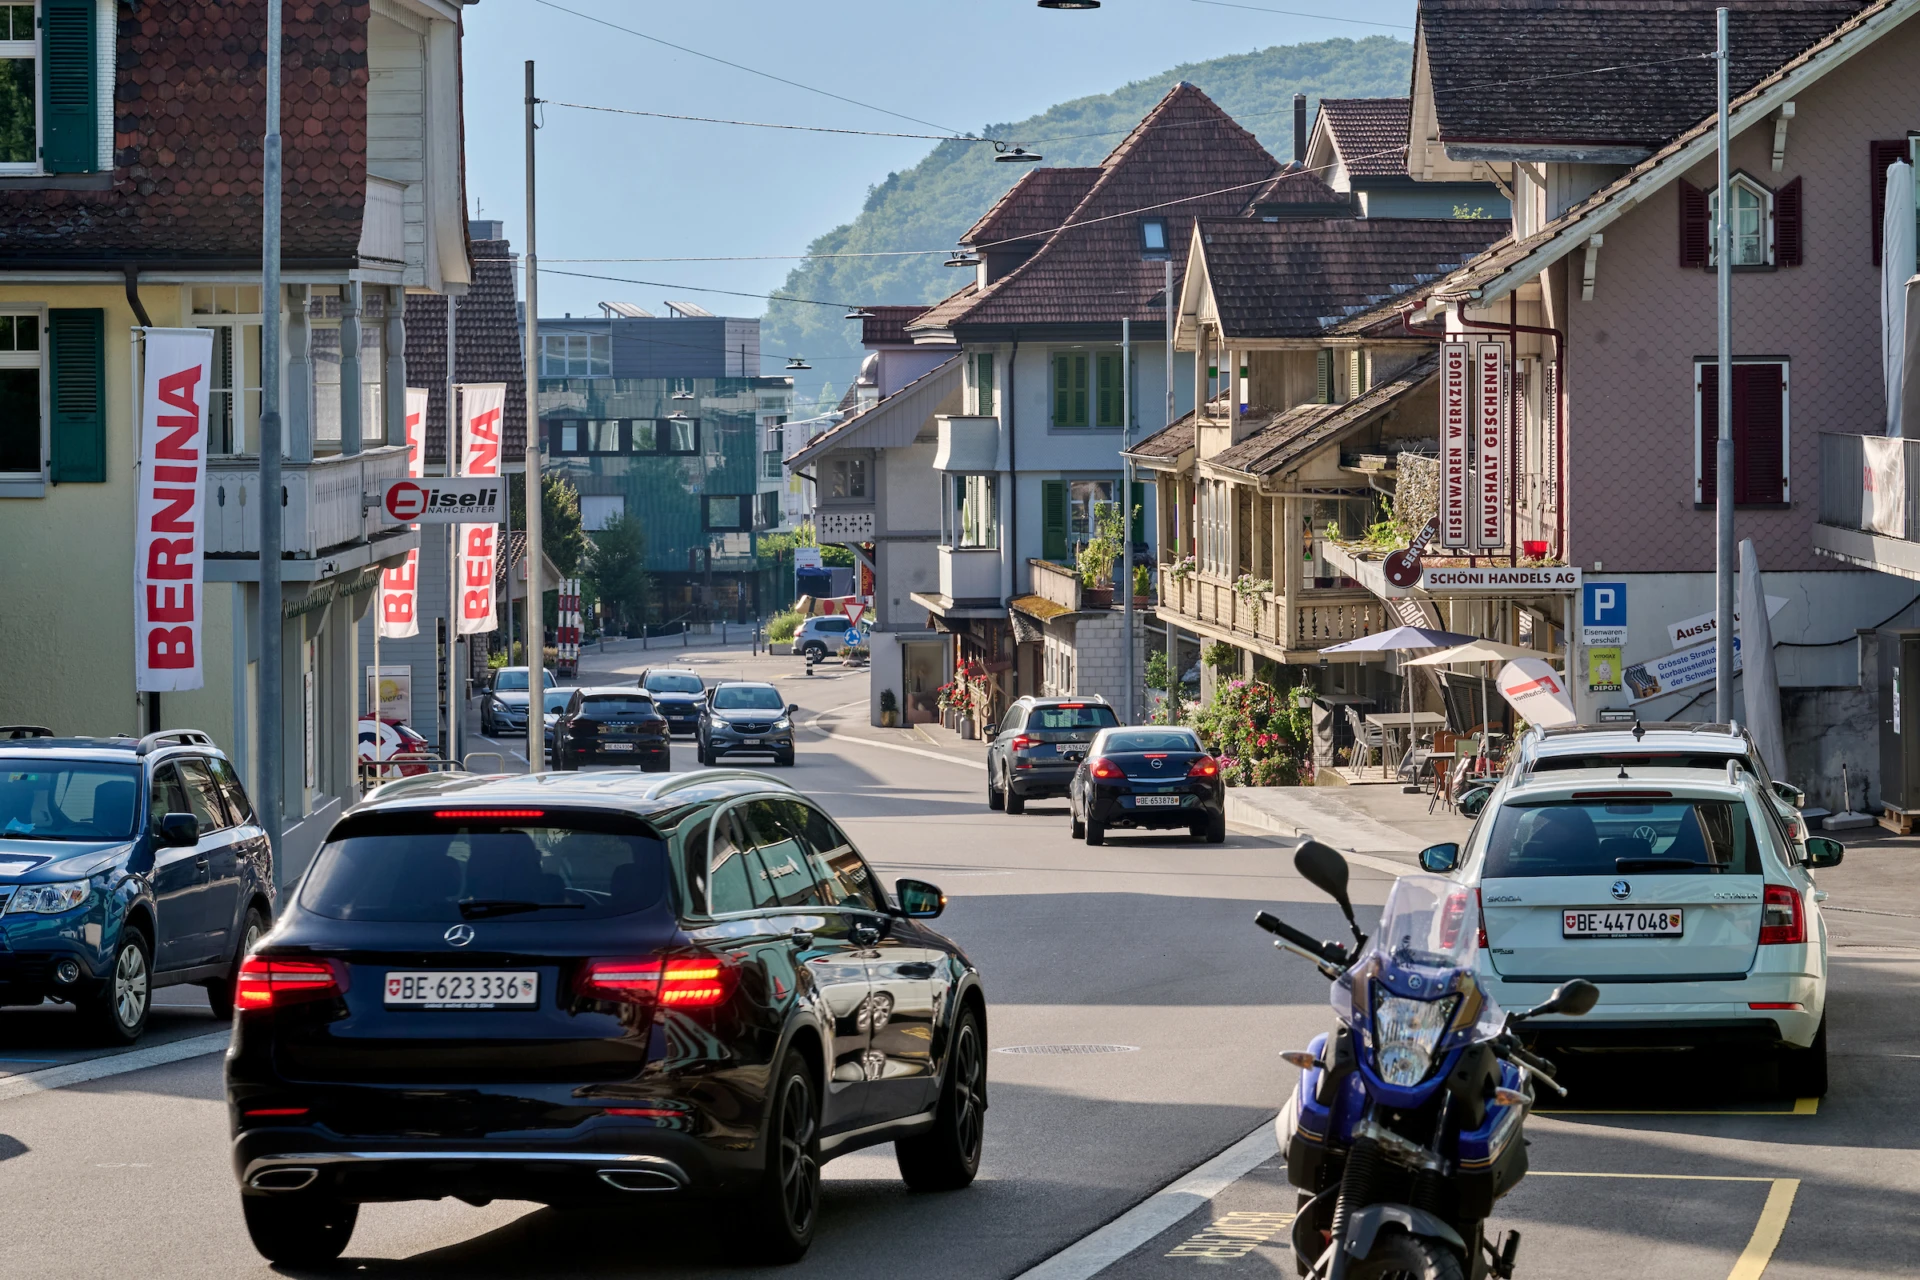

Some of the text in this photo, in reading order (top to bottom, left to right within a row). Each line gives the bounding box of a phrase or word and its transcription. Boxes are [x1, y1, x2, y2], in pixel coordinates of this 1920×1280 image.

[1449, 351, 1462, 539] EISENWAREN WERKZEUGE
[1484, 352, 1498, 538] HAUSHALT GESCHENKE
[146, 364, 202, 669] BERNINA
[464, 407, 500, 619] BERNA
[1401, 525, 1435, 570] SERVICE
[1430, 570, 1576, 585] SCHÖNI HANDELS AG
[1595, 588, 1616, 621] P
[1584, 628, 1626, 637] Eisenwaren-
[1590, 635, 1621, 645] geschäft
[1657, 656, 1689, 671] Grösste
[1659, 657, 1717, 680] korbausstellun
[1670, 667, 1717, 687] der Schweiz
